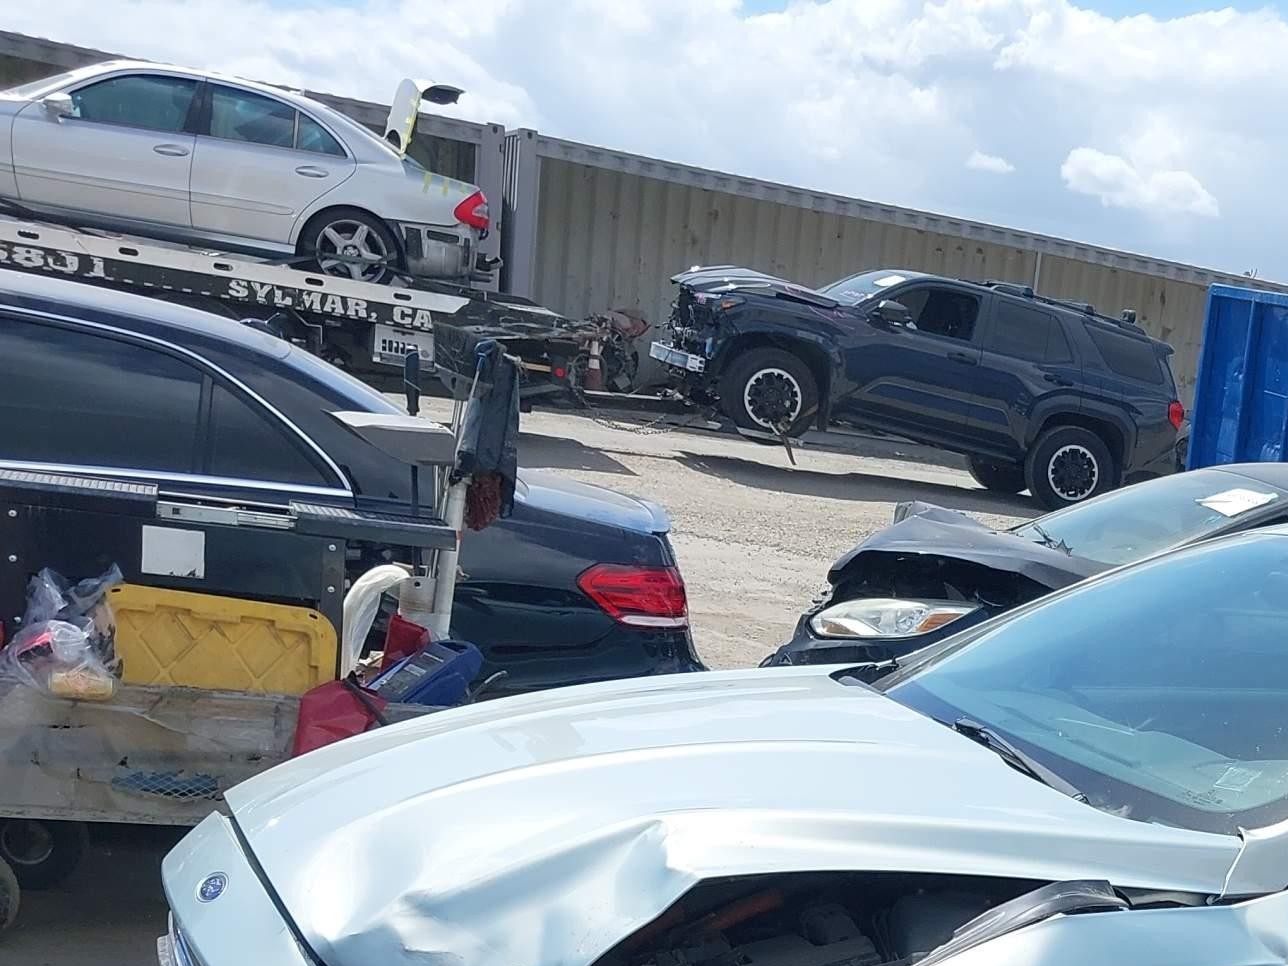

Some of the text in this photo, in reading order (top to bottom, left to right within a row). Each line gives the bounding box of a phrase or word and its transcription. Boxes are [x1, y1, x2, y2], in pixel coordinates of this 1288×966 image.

[0, 245, 104, 278] 801
[228, 279, 434, 329] SYLMAR, CA
